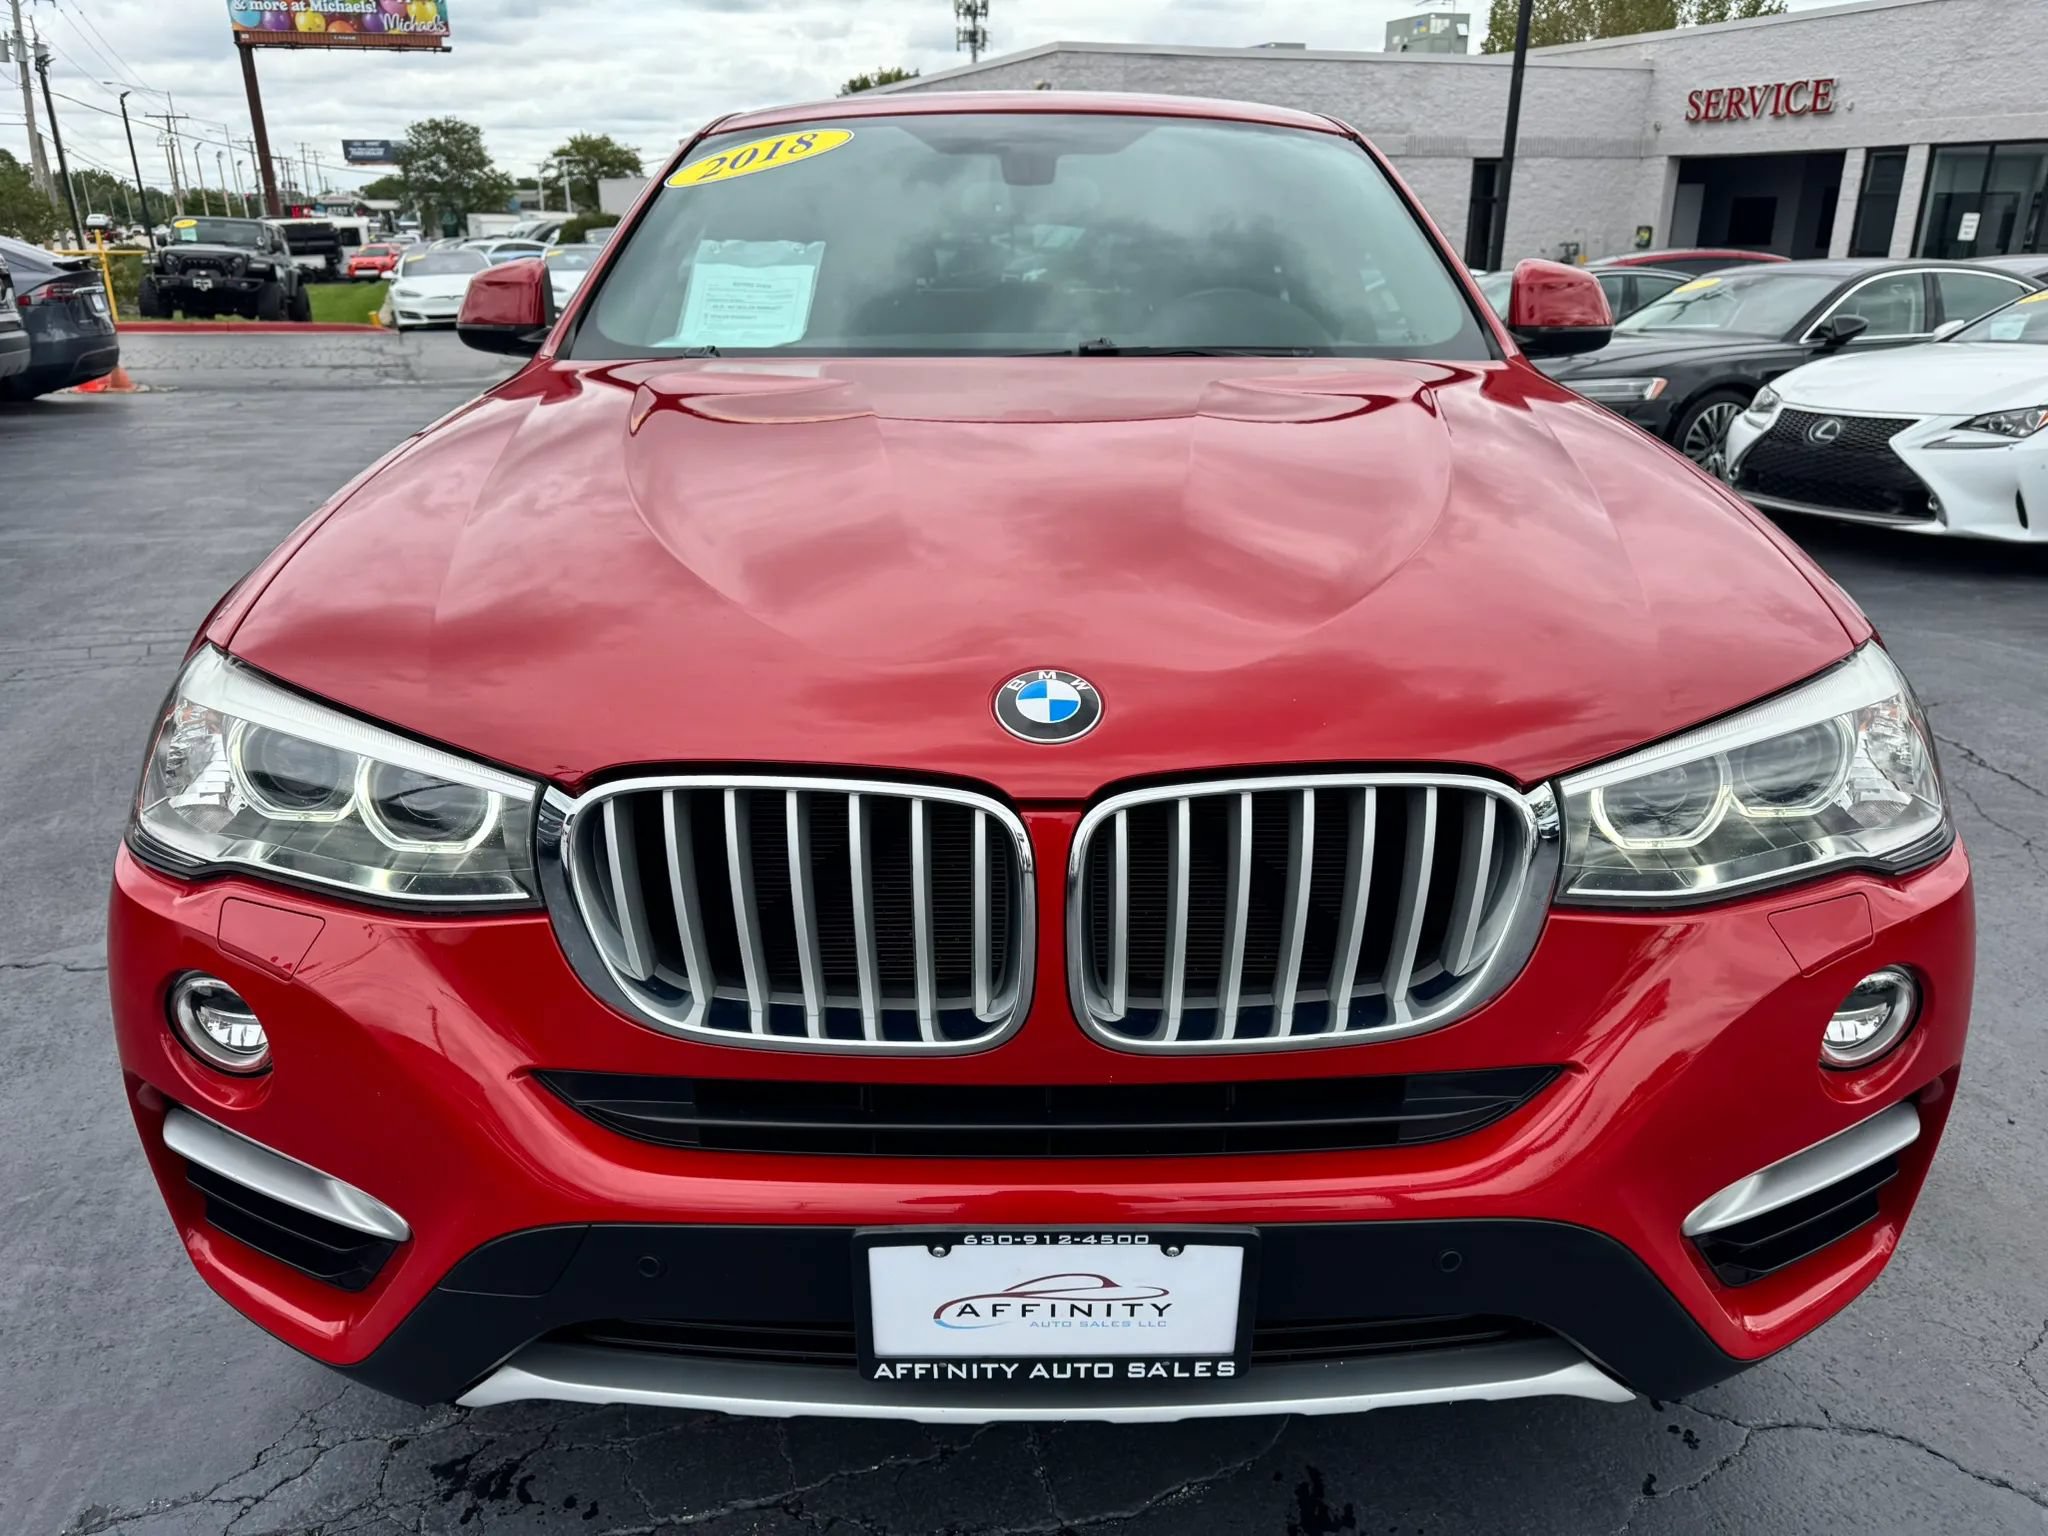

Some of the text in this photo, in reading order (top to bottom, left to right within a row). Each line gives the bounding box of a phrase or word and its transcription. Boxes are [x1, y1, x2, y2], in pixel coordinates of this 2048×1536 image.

[234, 0, 377, 13] & more at Michaels!
[382, 13, 446, 33] Michaels
[1685, 78, 1835, 121] SERVICE
[696, 133, 818, 181] 2018
[1006, 671, 1091, 691] BMW
[963, 1234, 1150, 1245] 630-912-4500
[956, 1303, 1173, 1318] AFFINITY
[1029, 1320, 1167, 1328] AUTO SALES LLC
[873, 1361, 1235, 1379] AFFINITY AUTO SALES
